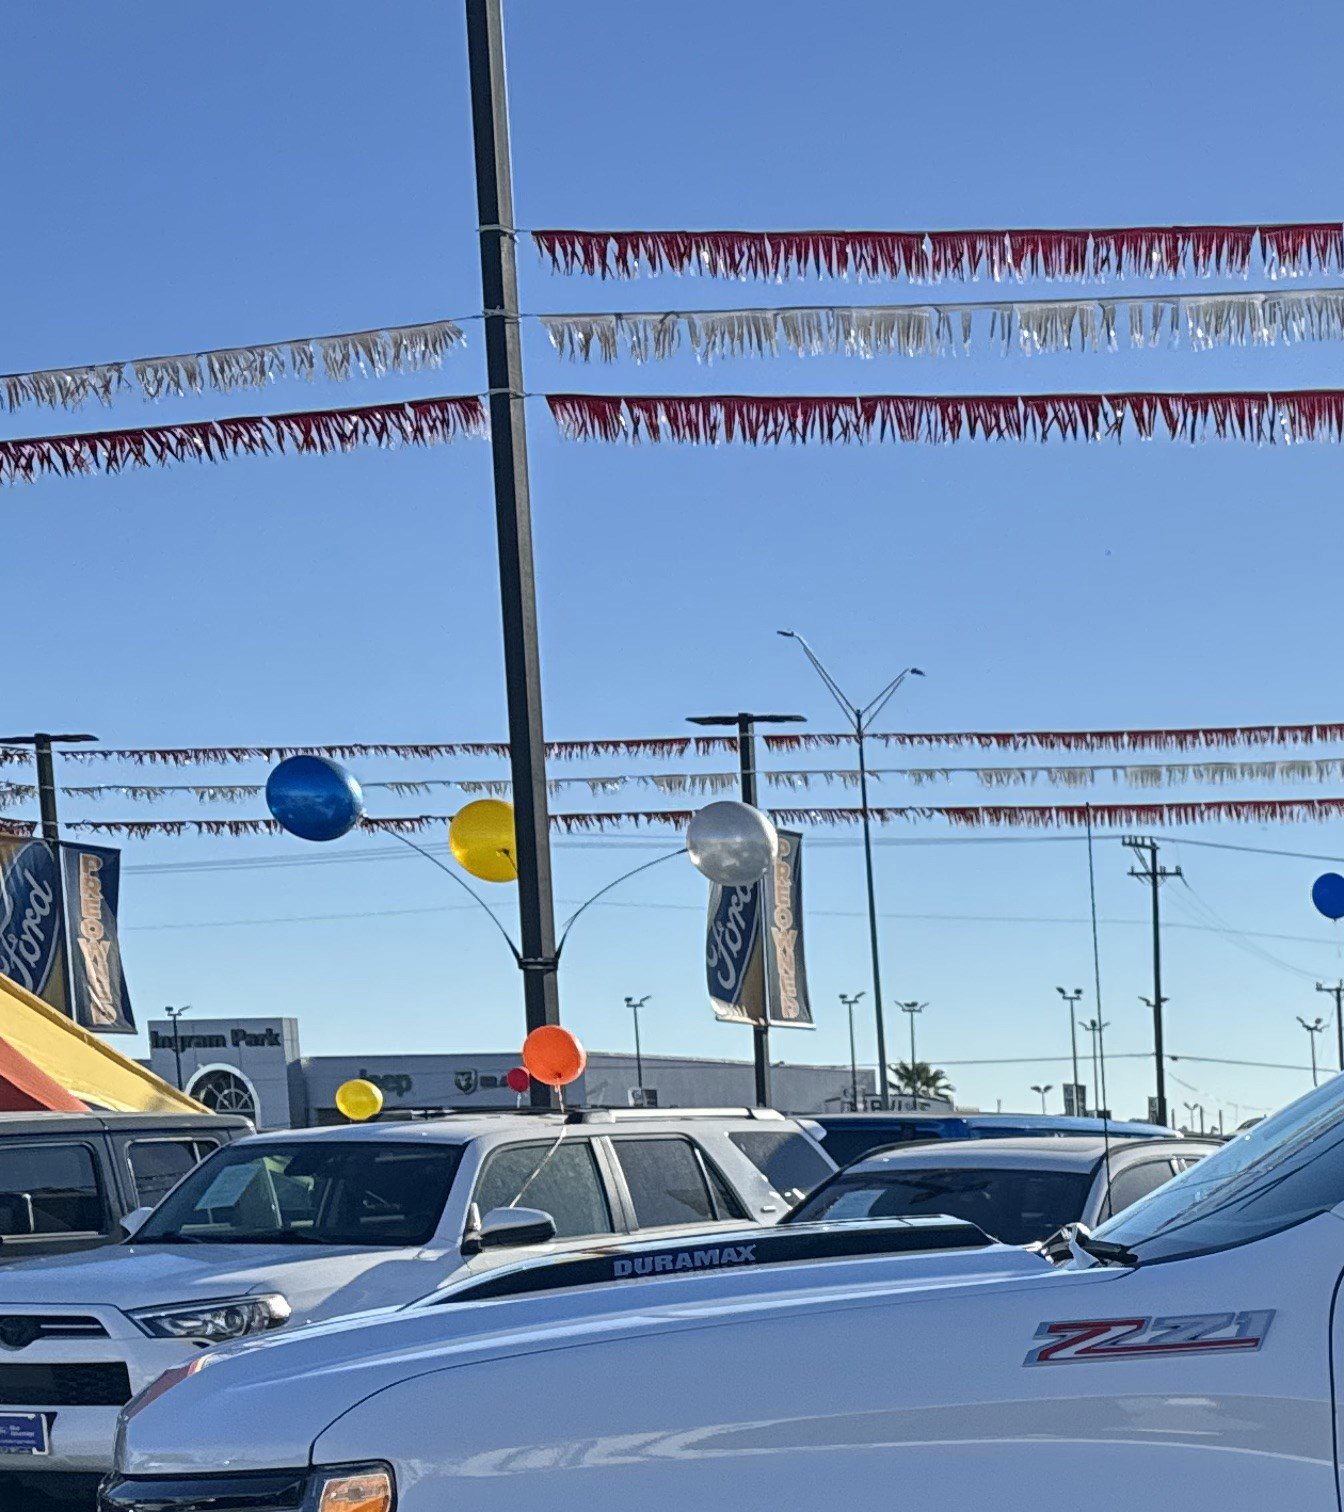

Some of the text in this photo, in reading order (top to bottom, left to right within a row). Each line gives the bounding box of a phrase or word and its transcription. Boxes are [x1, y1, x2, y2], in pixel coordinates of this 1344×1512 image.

[77, 852, 117, 1025] PREOWND
[231, 1028, 281, 1047] Park
[359, 1069, 413, 1097] eep
[613, 1244, 757, 1277] DURAMAX
[1022, 1309, 1277, 1368] Z71
